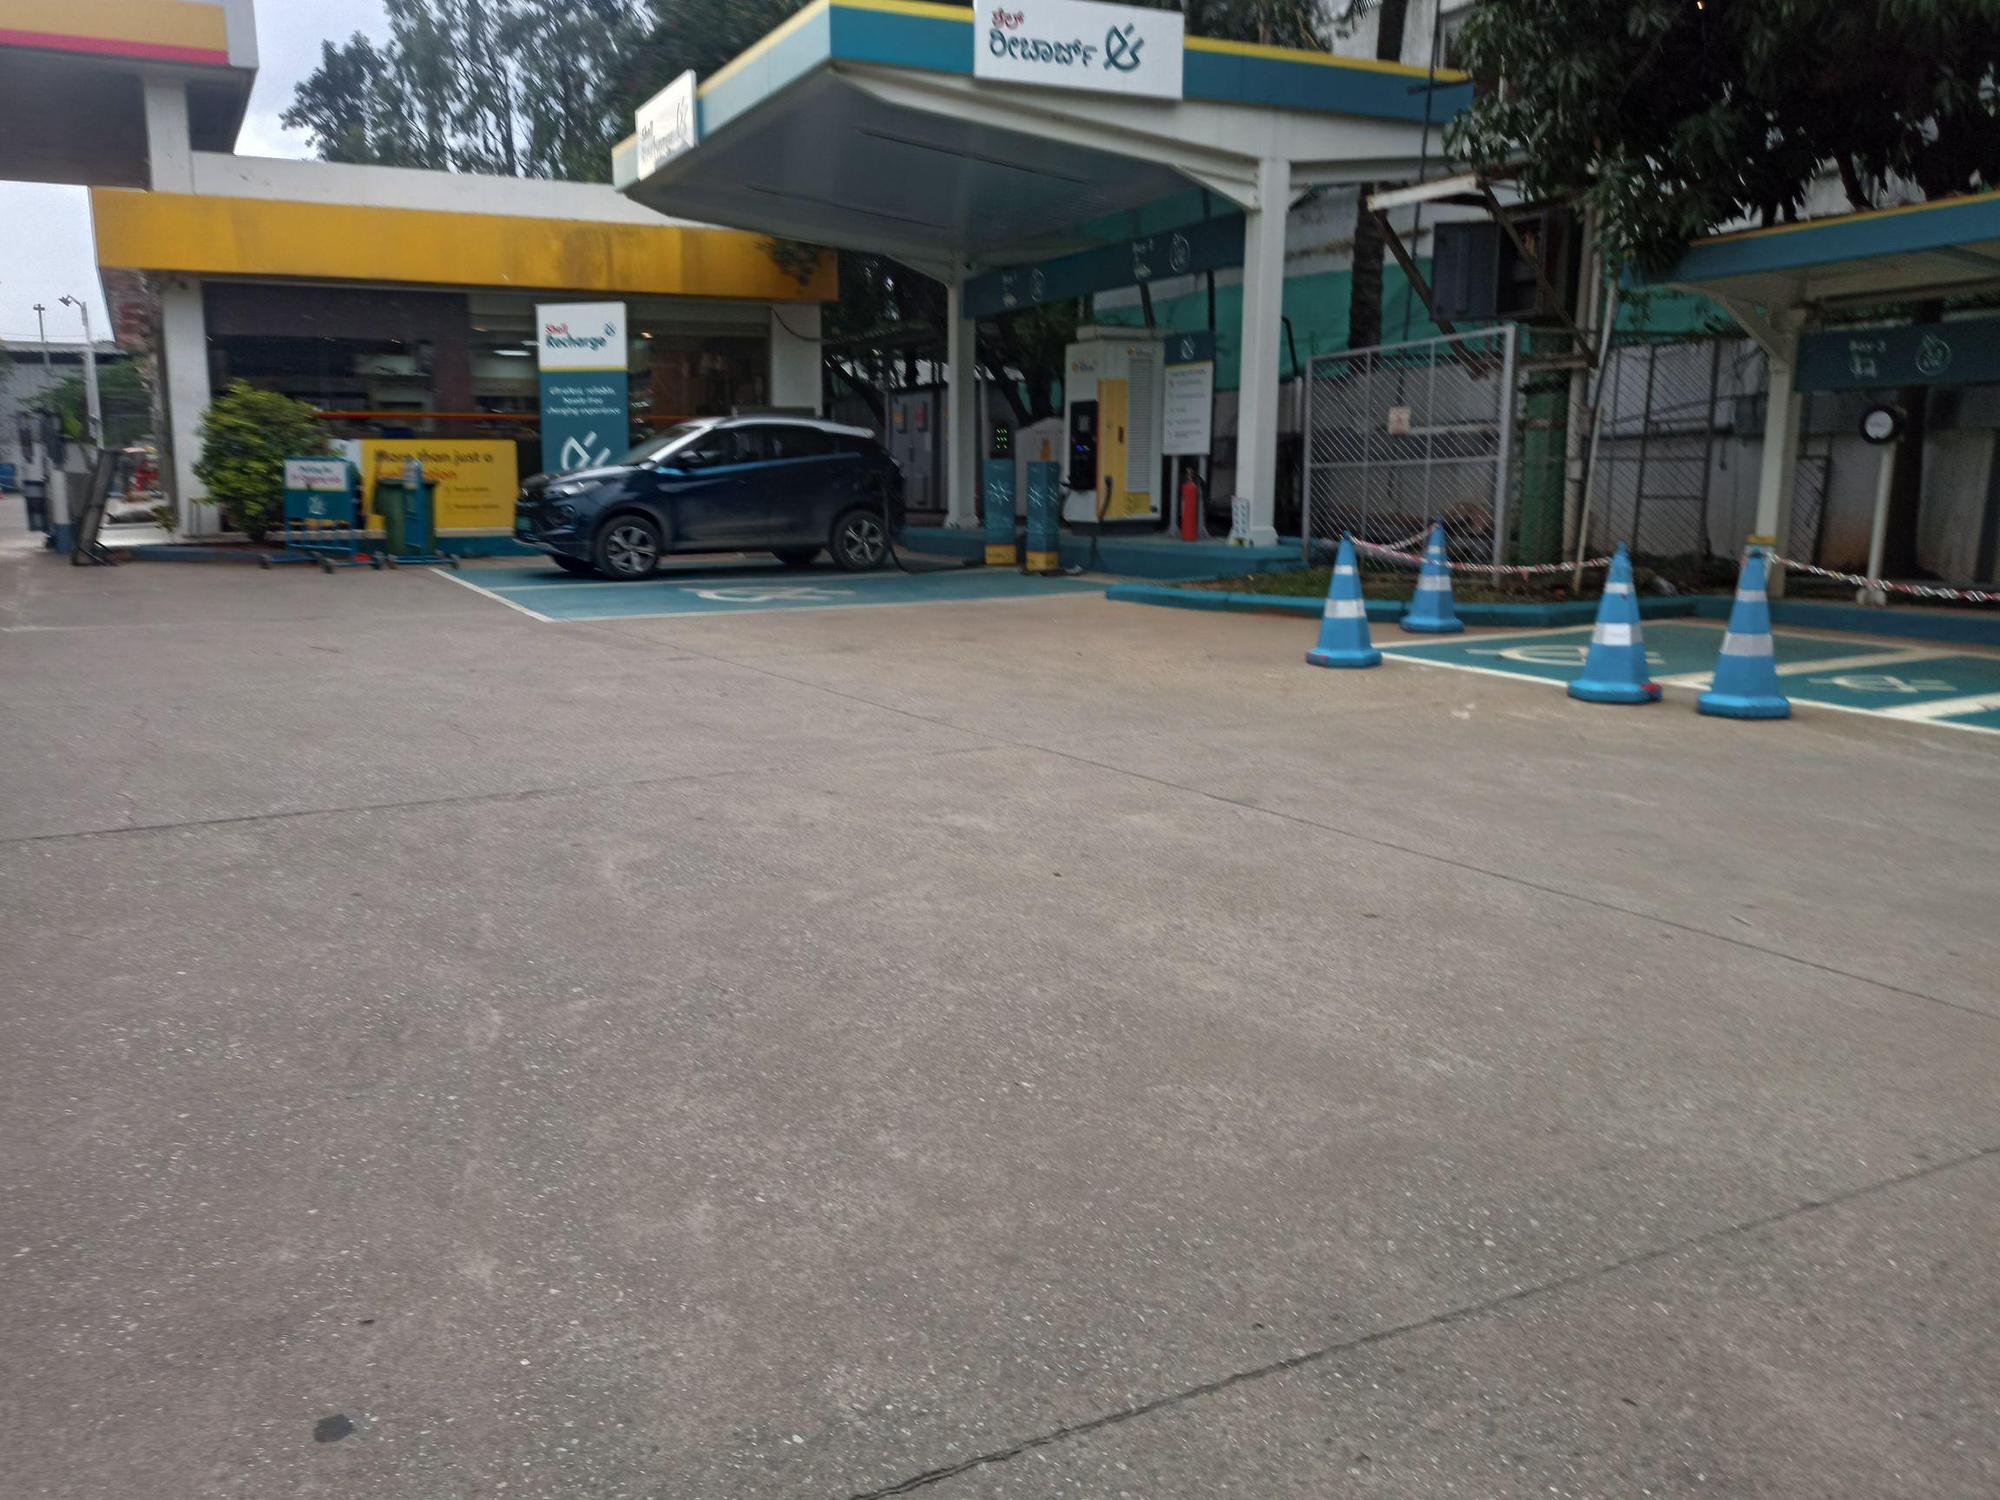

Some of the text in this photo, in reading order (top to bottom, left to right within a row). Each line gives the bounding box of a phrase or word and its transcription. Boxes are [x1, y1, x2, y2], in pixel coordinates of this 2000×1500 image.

[545, 323, 568, 335] Shell
[546, 332, 608, 351] Recharge
[417, 449, 450, 463] than
[453, 449, 480, 466] just
